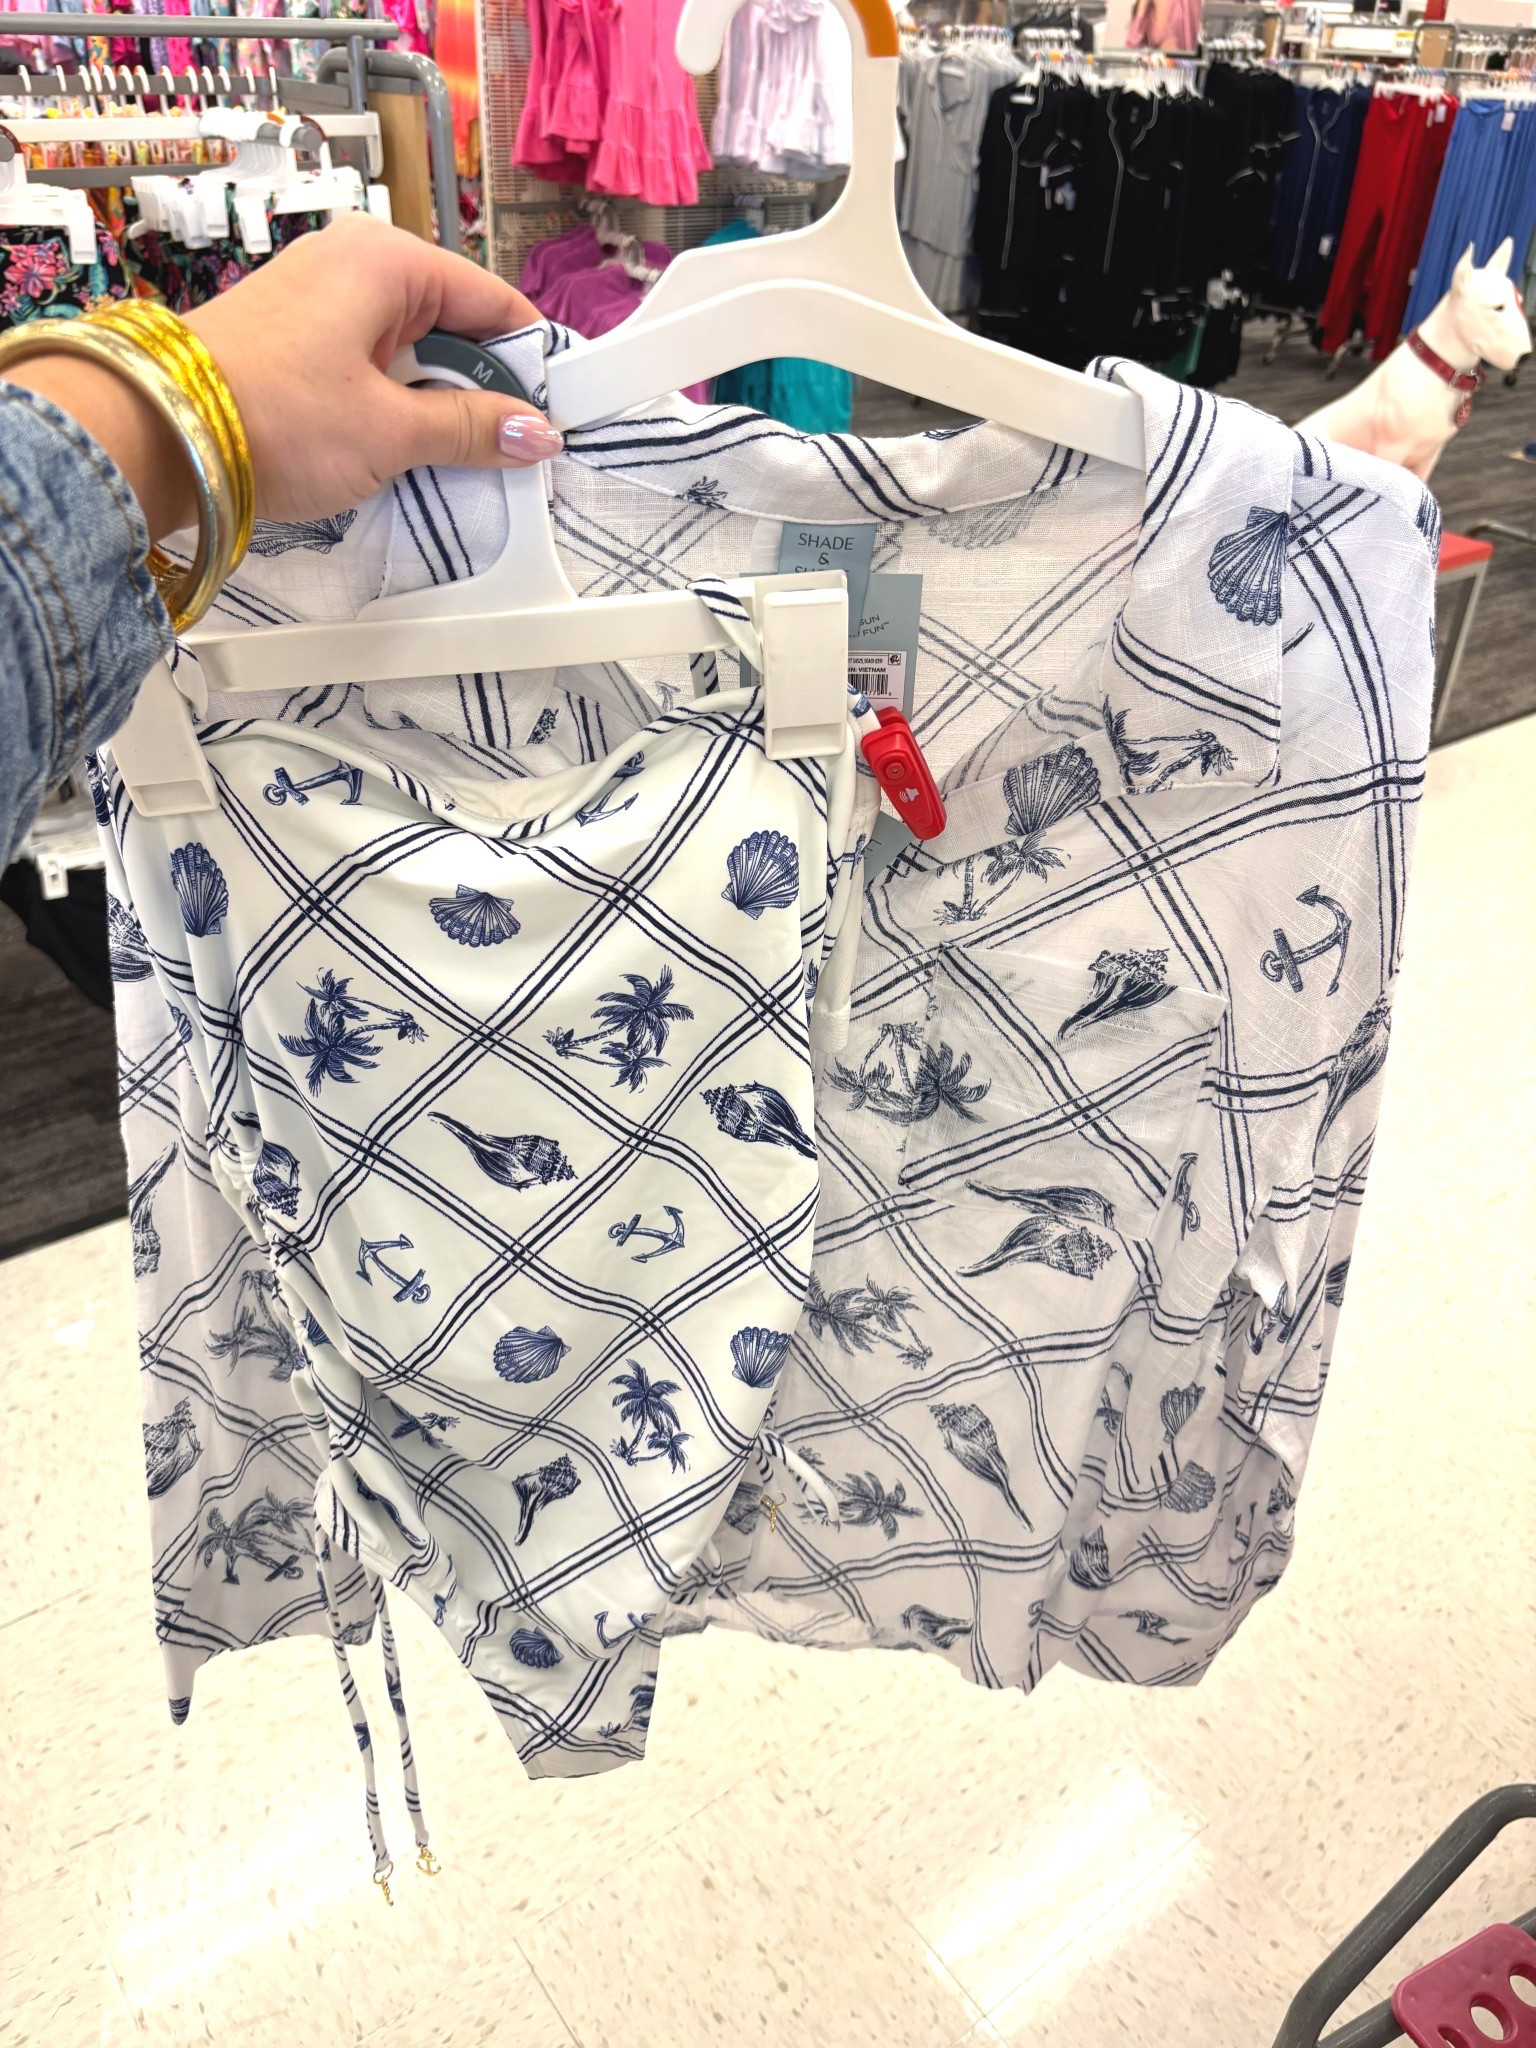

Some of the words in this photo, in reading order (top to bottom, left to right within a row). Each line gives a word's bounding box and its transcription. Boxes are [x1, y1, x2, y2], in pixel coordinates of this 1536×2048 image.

[472, 360, 495, 384] M
[797, 532, 855, 551] SHADE
[818, 552, 830, 566] &
[859, 613, 880, 626] SUN
